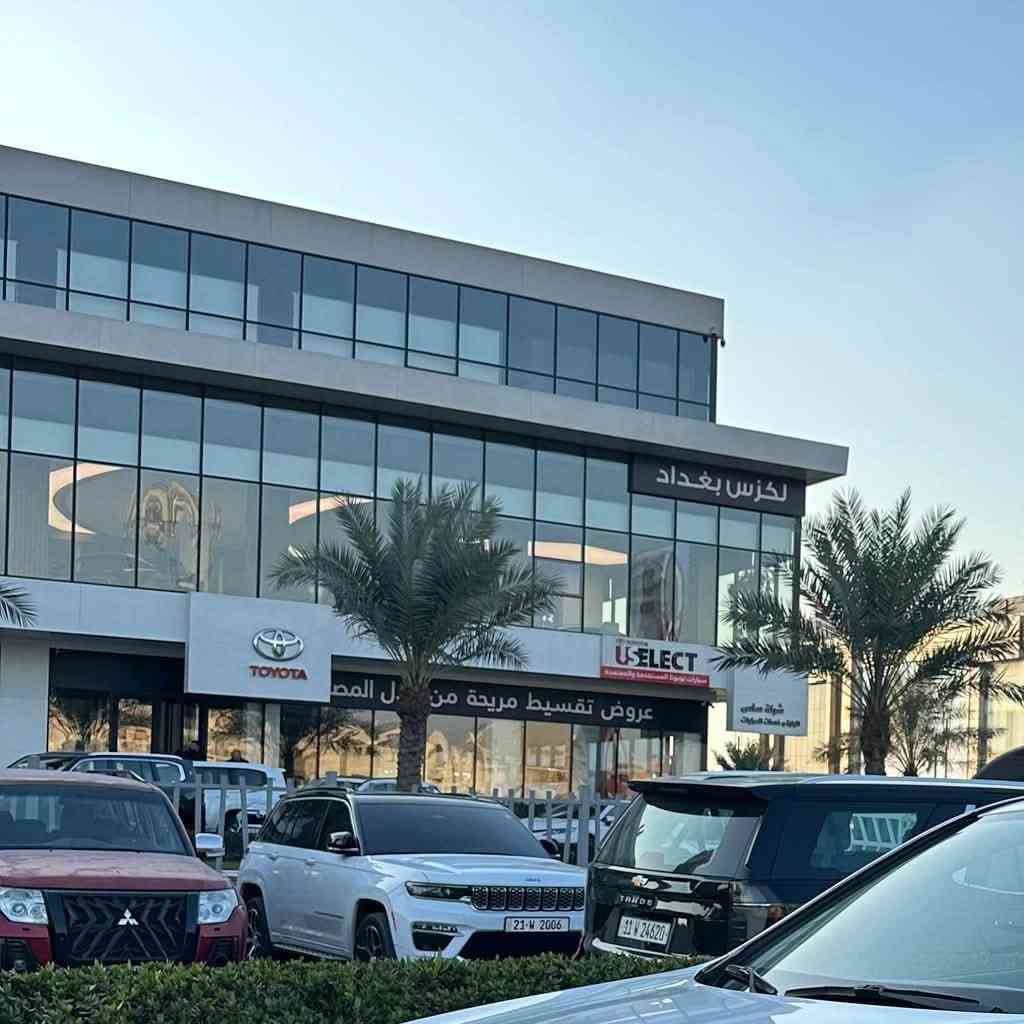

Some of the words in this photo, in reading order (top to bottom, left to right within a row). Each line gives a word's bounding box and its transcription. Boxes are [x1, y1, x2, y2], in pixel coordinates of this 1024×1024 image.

[656, 465, 721, 497] بغداد
[725, 479, 787, 502] لكزس
[249, 664, 308, 681] TOYOTA
[429, 689, 458, 708] من
[466, 689, 518, 713] مريحة
[526, 691, 594, 716] تقسيط
[600, 701, 654, 722] عروض
[540, 919, 562, 930] 2006
